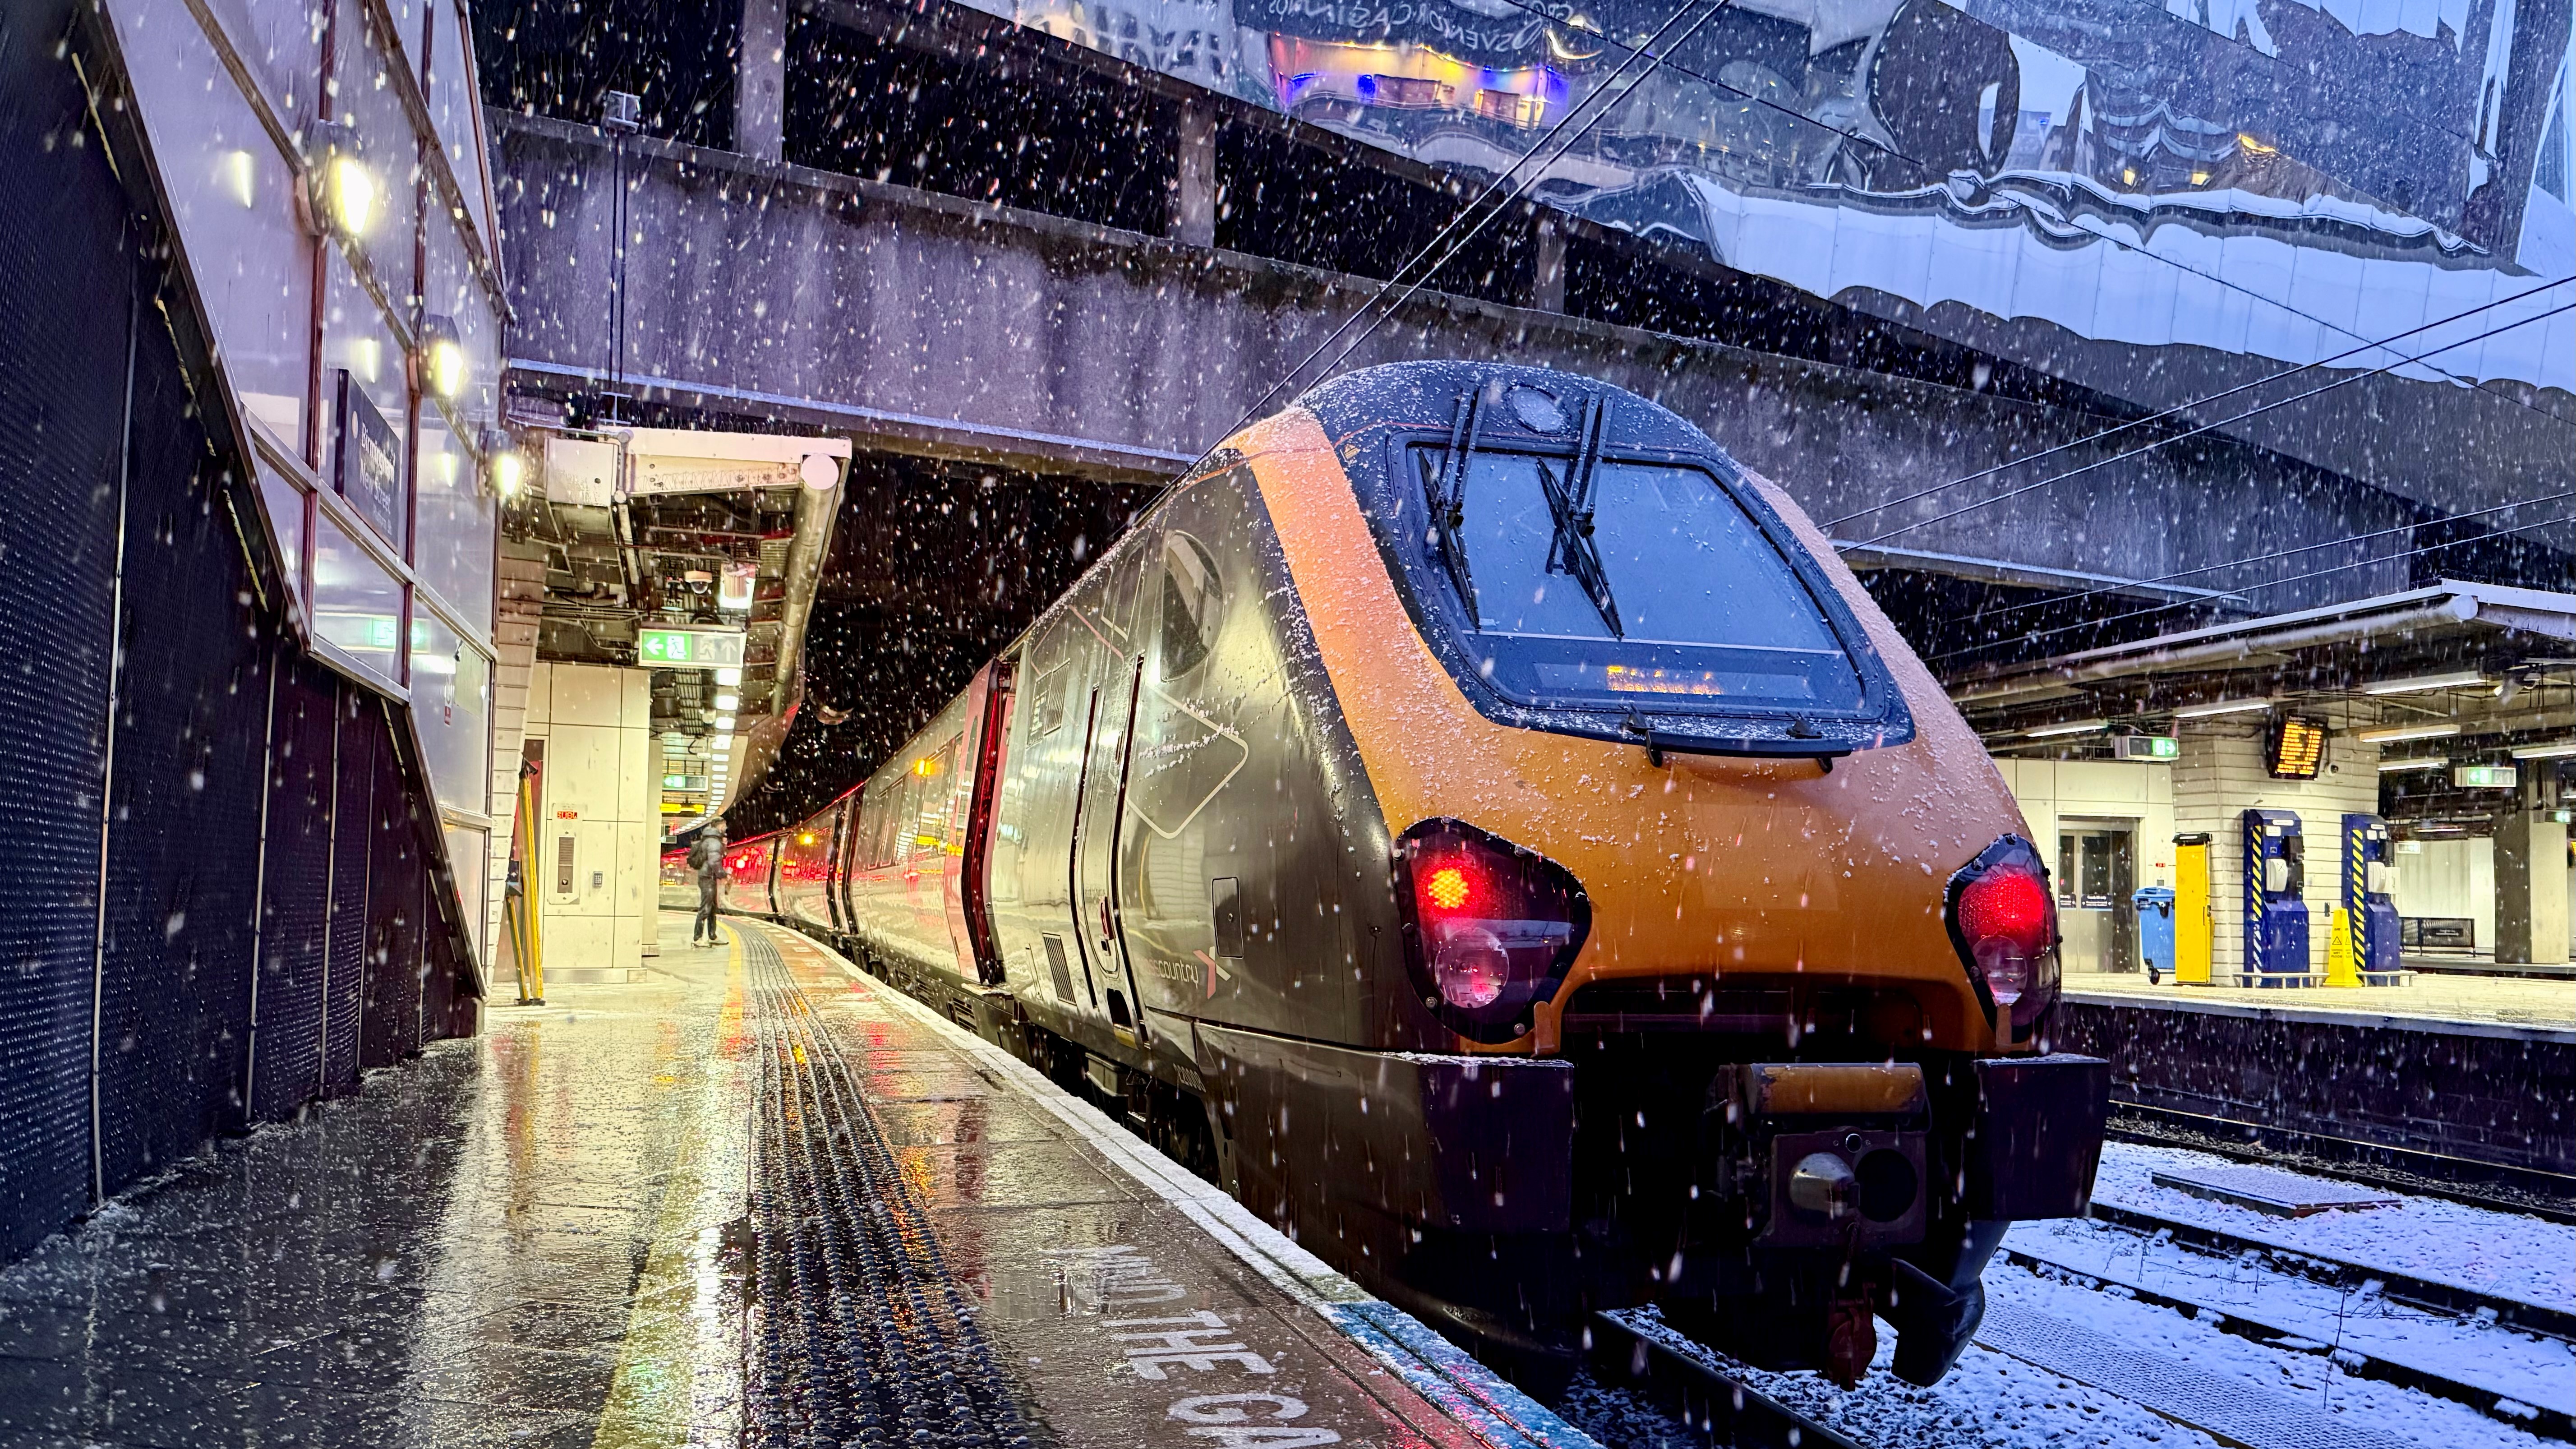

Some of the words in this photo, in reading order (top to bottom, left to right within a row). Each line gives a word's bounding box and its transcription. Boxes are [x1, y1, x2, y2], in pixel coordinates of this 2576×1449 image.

[360, 458, 373, 495] New
[374, 476, 391, 515] Street
[1102, 1310, 1276, 1380] THE
